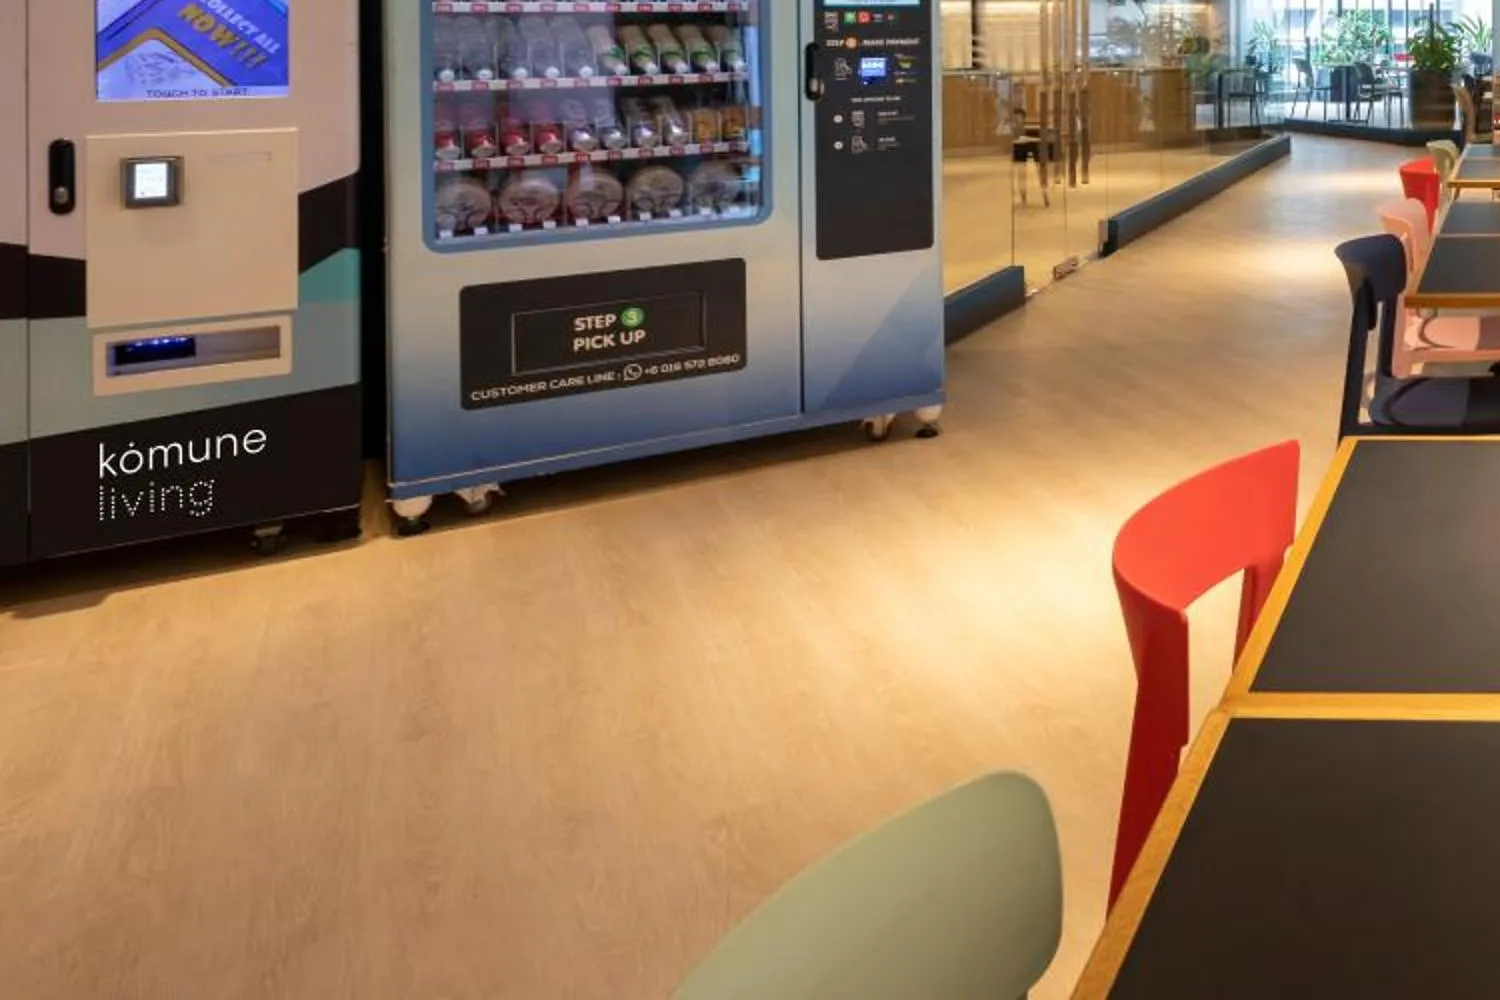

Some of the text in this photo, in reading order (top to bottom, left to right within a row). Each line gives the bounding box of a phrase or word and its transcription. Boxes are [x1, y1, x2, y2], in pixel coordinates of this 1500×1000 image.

[178, 1, 268, 70] NOW!!!
[253, 32, 281, 55] ALL
[146, 88, 189, 98] TOUCH
[192, 87, 209, 97] TO
[574, 313, 618, 332] STEP
[573, 328, 647, 353] PICK UP
[470, 380, 547, 402] CUSTOMER
[549, 375, 585, 390] CARE
[98, 478, 216, 522] living
